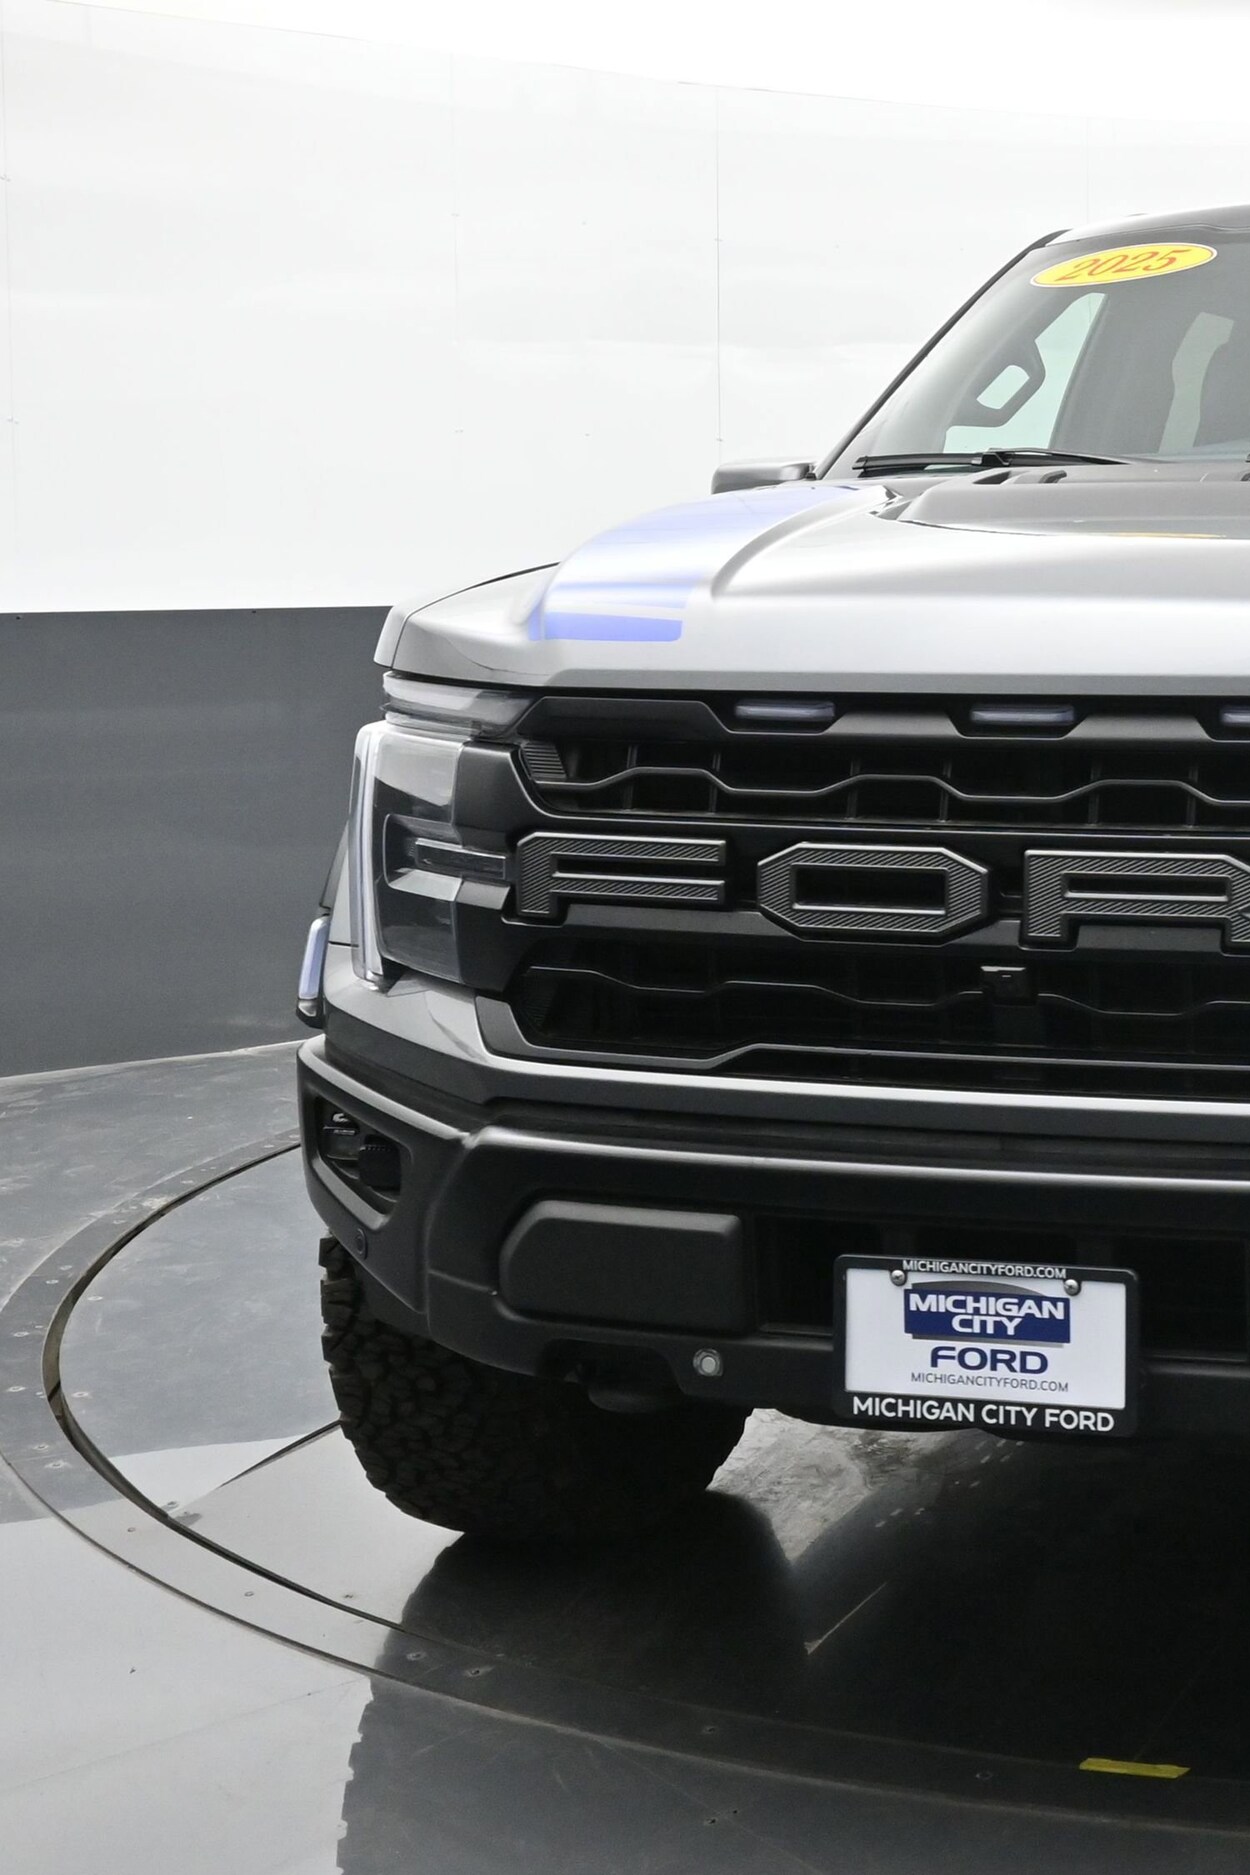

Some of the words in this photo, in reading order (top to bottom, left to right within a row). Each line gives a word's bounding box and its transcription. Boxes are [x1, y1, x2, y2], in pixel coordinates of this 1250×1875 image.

[1055, 249, 1192, 282] 2025
[902, 1260, 1067, 1279] MICHIGANCITYFORD.COM
[909, 1293, 1065, 1320] MICHIGAN
[952, 1314, 1022, 1336] CITY
[930, 1346, 1048, 1375] FORD
[911, 1372, 1069, 1393] MICHIGANCITYFORD.COM
[853, 1396, 974, 1423] MICHIGAN
[981, 1404, 1037, 1427] CITY
[1045, 1409, 1115, 1432] FORD
